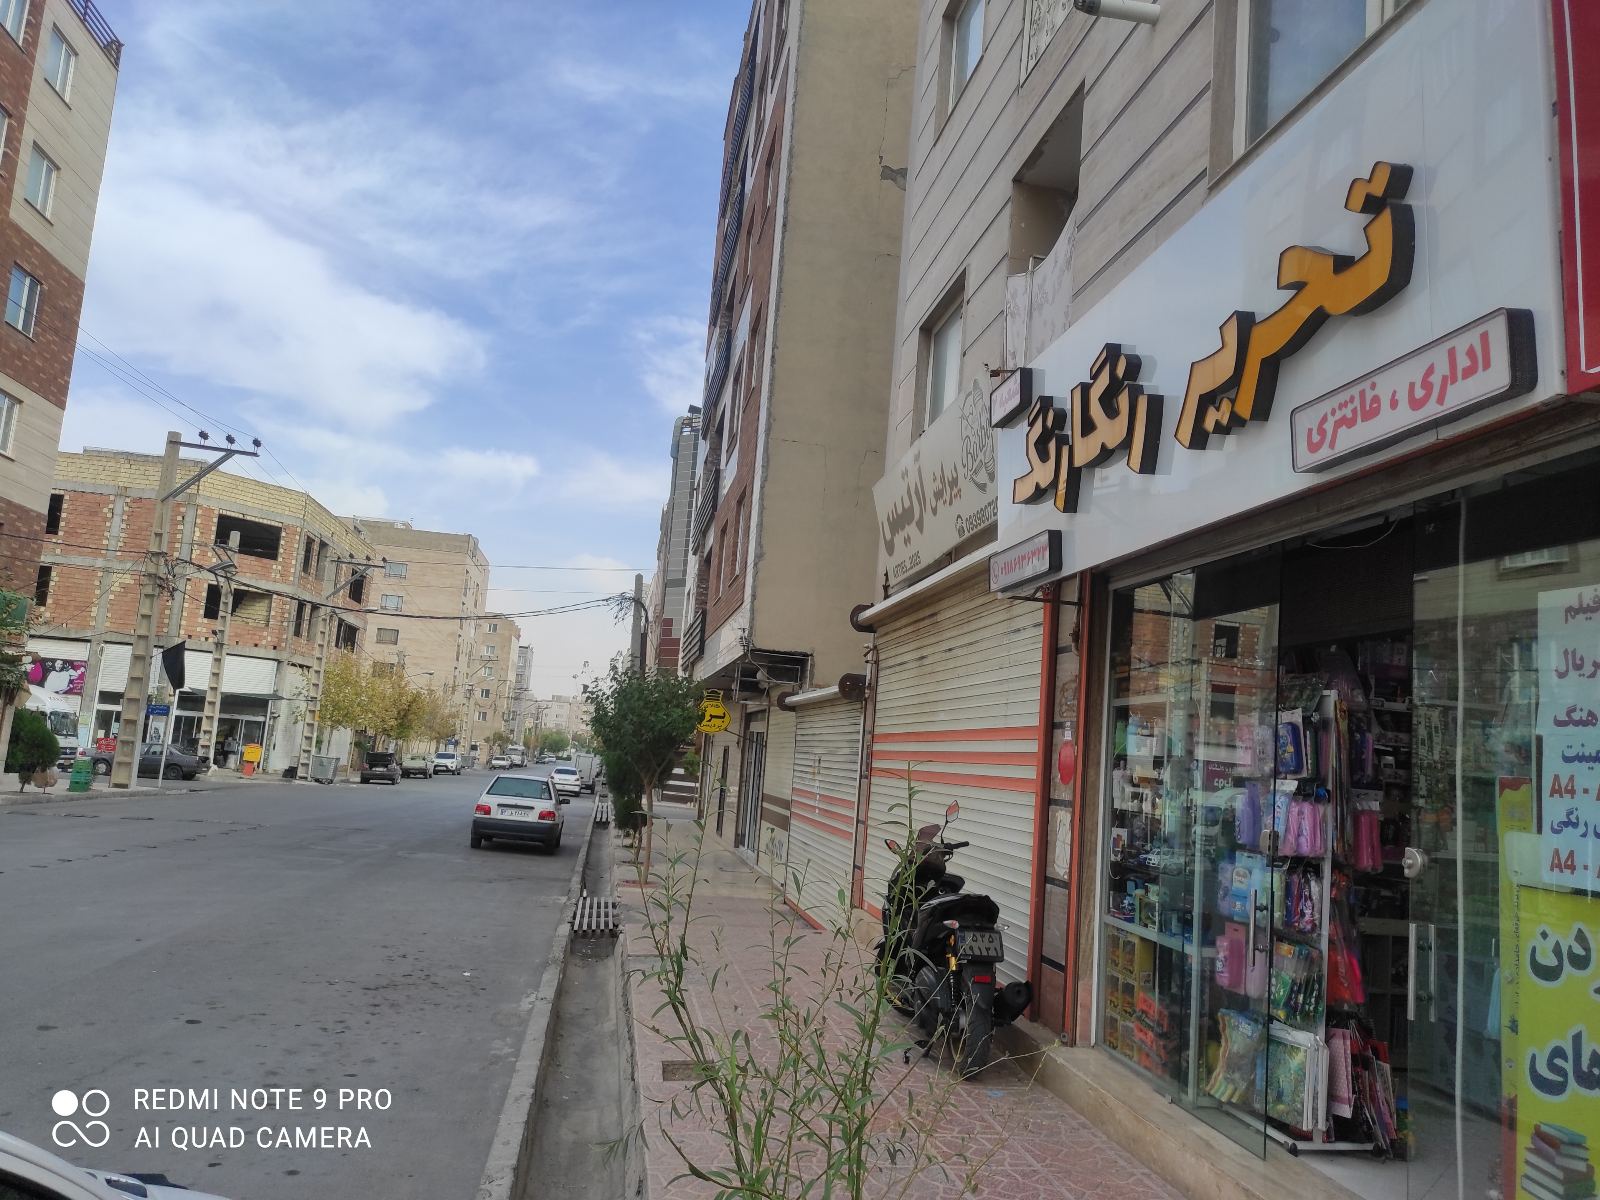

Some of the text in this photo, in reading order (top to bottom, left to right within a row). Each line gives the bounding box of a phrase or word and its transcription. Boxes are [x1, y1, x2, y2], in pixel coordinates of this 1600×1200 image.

[1174, 160, 1416, 450] تحریر
[1407, 329, 1492, 412] اداری
[1306, 380, 1382, 455] فانتزی
[1548, 773, 1577, 800] A4
[1551, 806, 1589, 839] رنگی
[1549, 847, 1577, 875] A4
